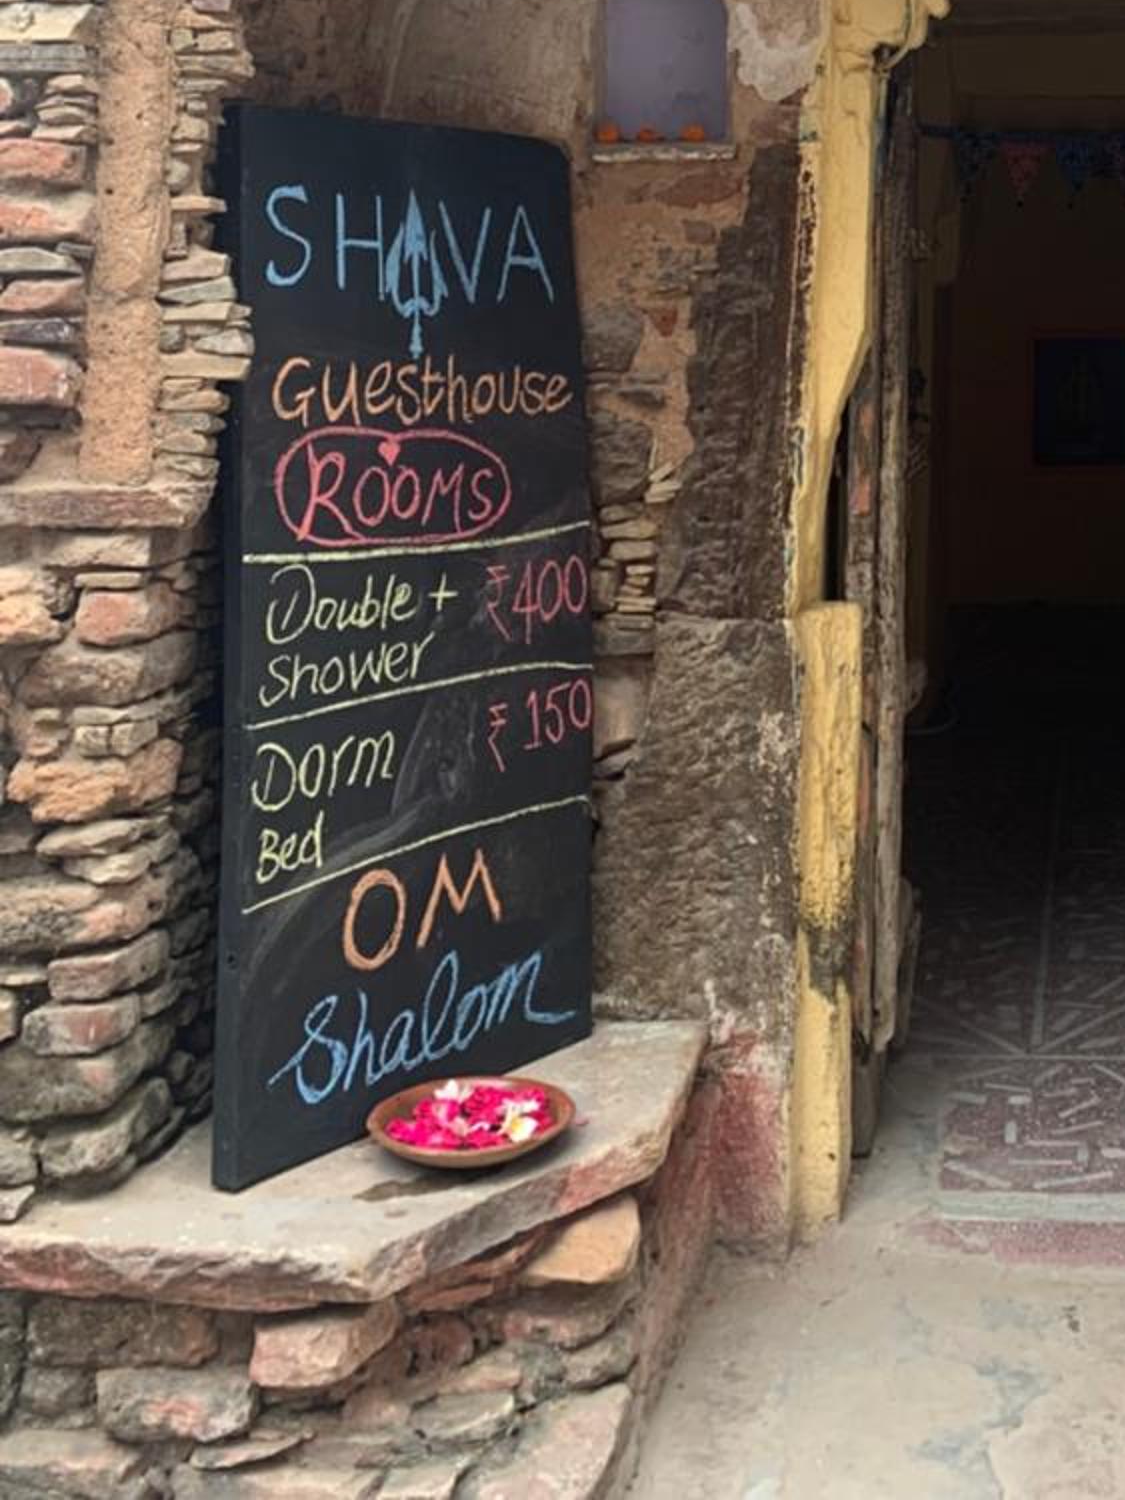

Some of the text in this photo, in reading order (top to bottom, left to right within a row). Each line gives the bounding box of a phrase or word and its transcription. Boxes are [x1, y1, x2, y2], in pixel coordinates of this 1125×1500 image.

[295, 440, 496, 541] ROOMS
[266, 563, 417, 644] Double
[251, 730, 395, 812] Dorm
[255, 809, 325, 885] Bed
[342, 847, 503, 972] OM
[265, 949, 577, 1105] Shalom
